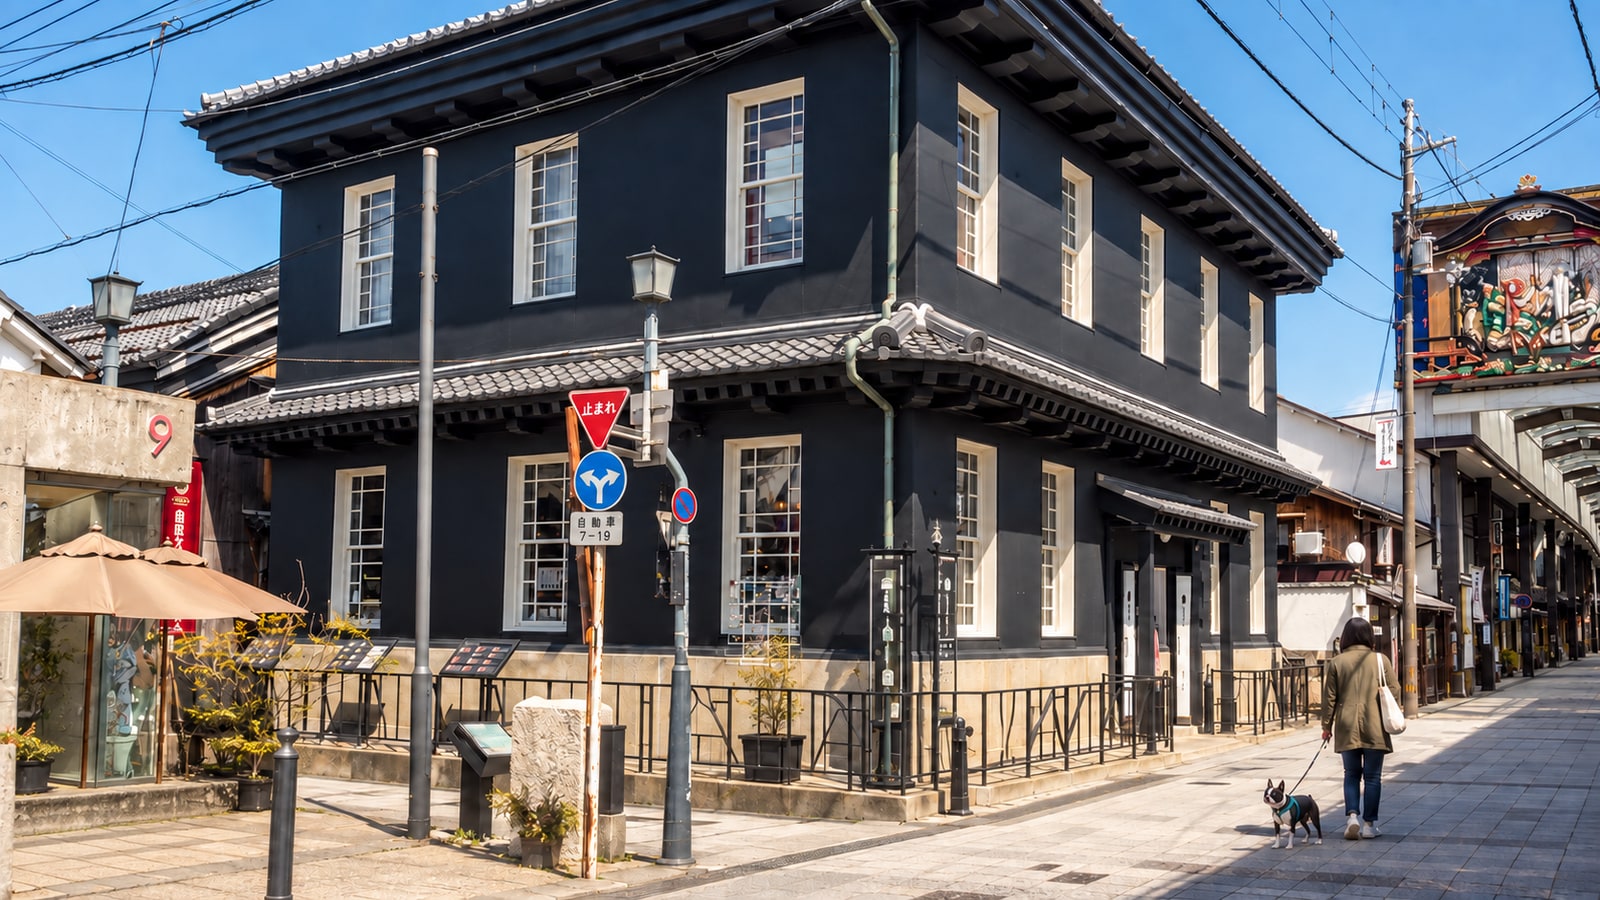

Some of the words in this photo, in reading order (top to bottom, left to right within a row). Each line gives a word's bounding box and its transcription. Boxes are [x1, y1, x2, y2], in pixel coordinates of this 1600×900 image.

[581, 401, 617, 416] 止まれ
[148, 415, 173, 458] 9
[578, 516, 615, 528] 自動車
[579, 531, 611, 542] 7-19
